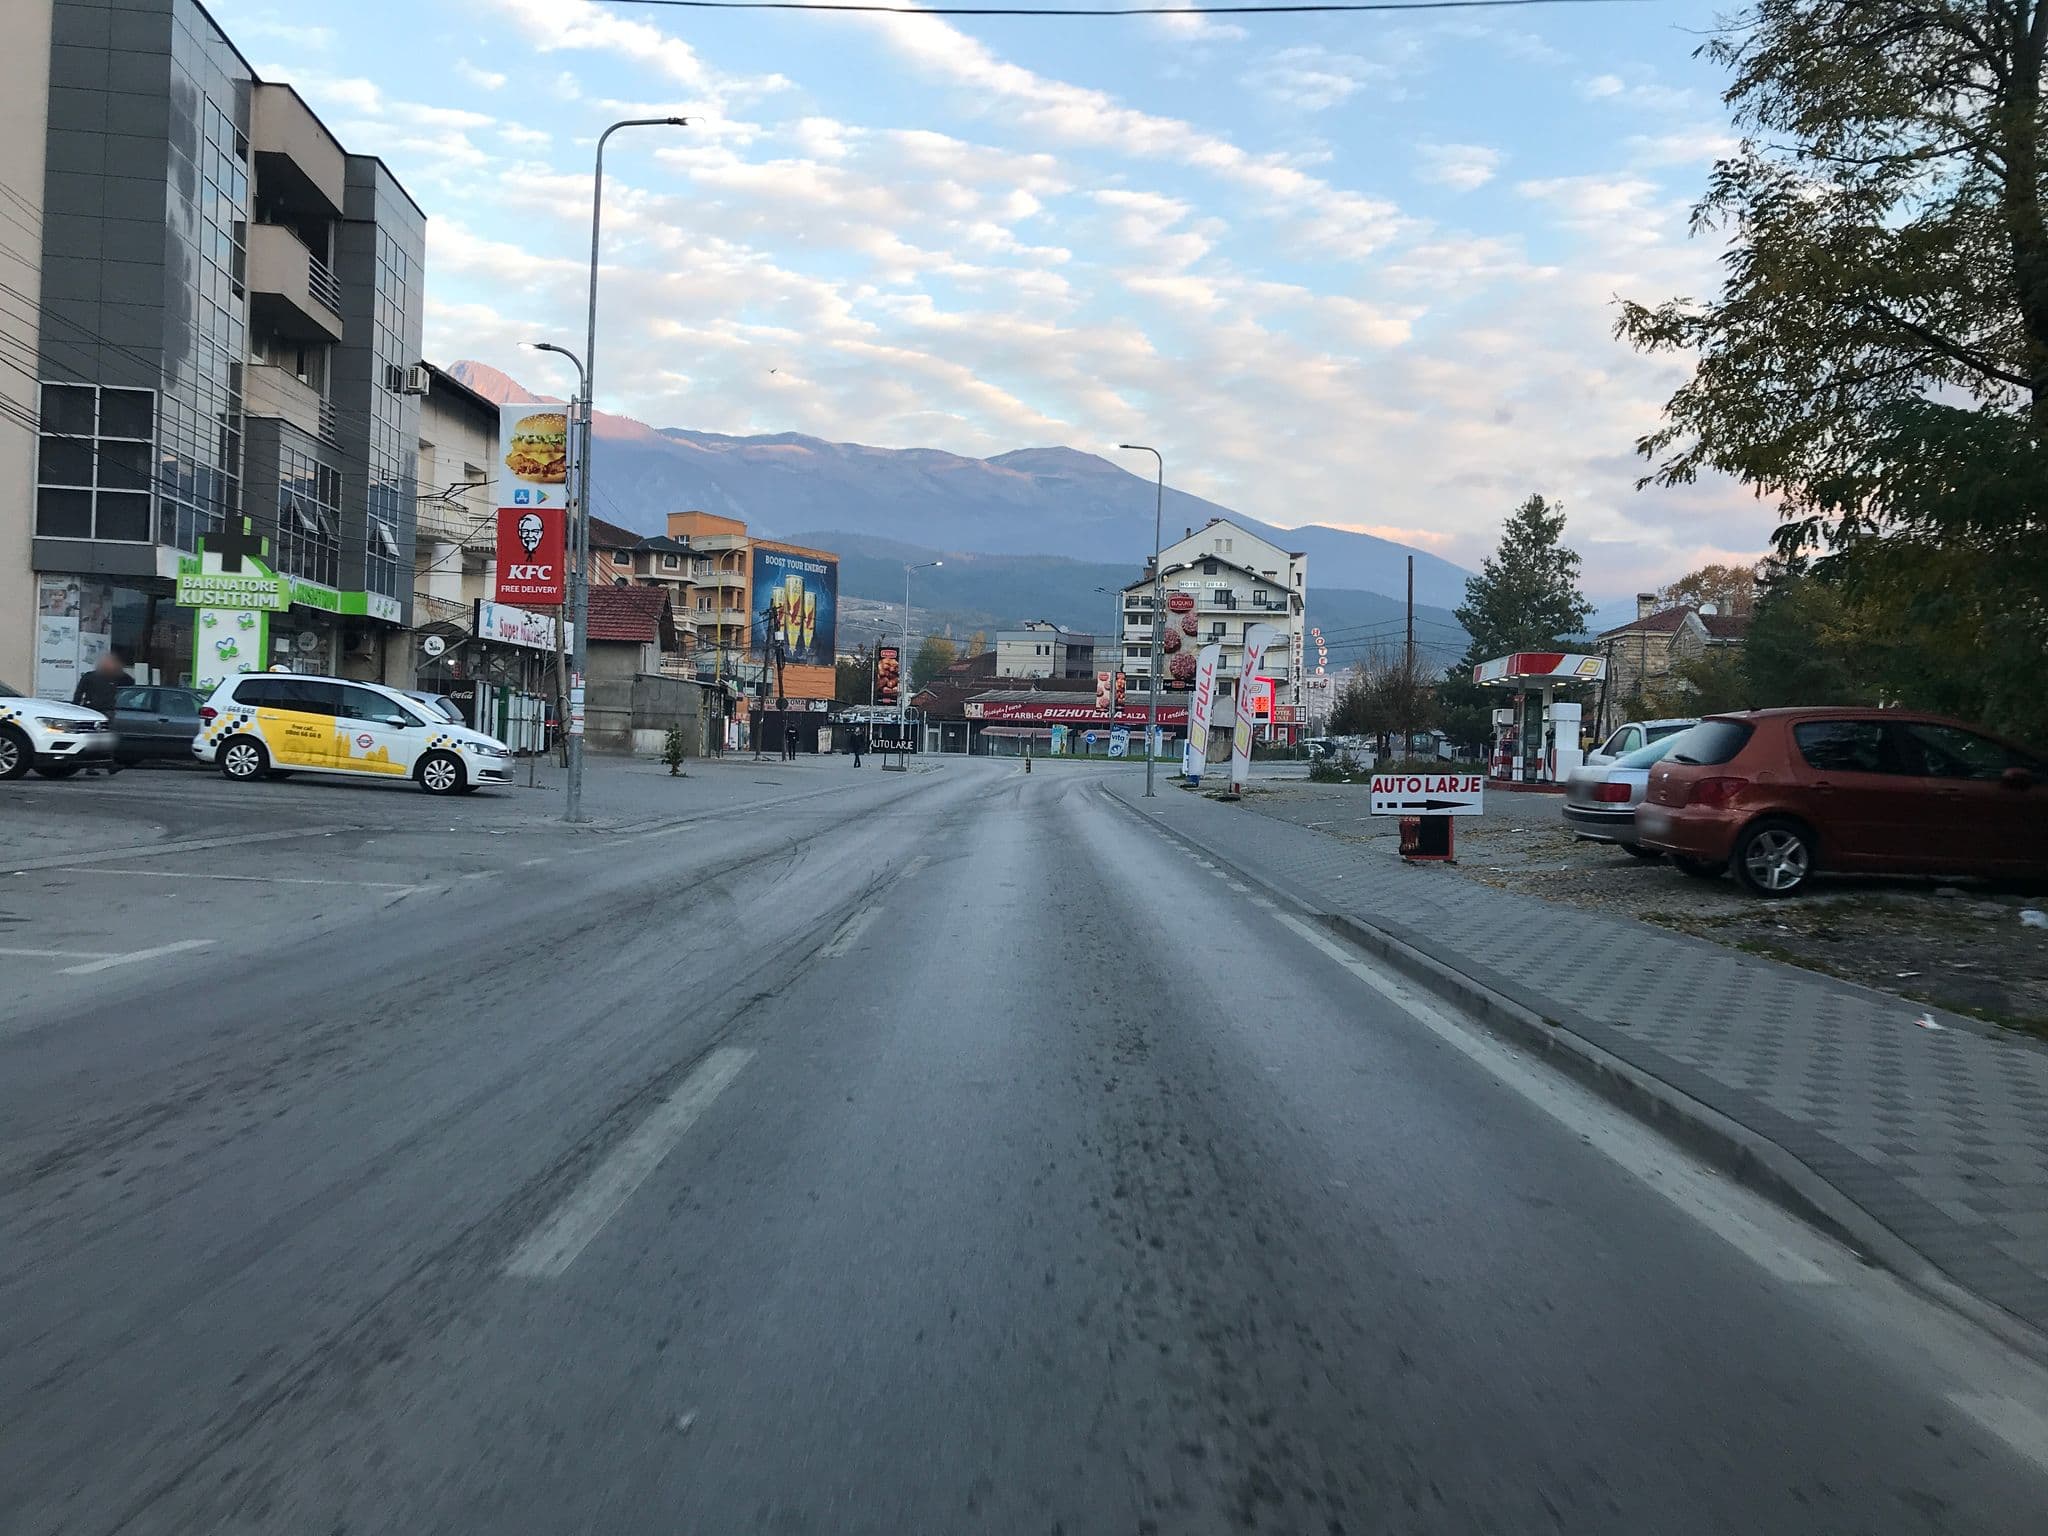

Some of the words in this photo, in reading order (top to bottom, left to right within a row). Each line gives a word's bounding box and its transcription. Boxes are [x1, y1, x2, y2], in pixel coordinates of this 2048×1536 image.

[507, 564, 552, 580] KFC
[765, 555, 785, 567] BOOST
[787, 560, 804, 570] YOUR
[804, 562, 828, 574] ENERGY
[182, 576, 279, 593] BARNATORE
[501, 585, 520, 593] FREE
[521, 585, 558, 594] DELIVERY
[179, 590, 280, 608] KUSHTRIMI
[1312, 629, 1327, 675] HOTEL
[1196, 663, 1212, 721] FULL
[870, 739, 890, 749] AUTO
[890, 740, 914, 750] LARJE
[1371, 777, 1421, 793] AUTO
[1425, 777, 1481, 793] LARJE
